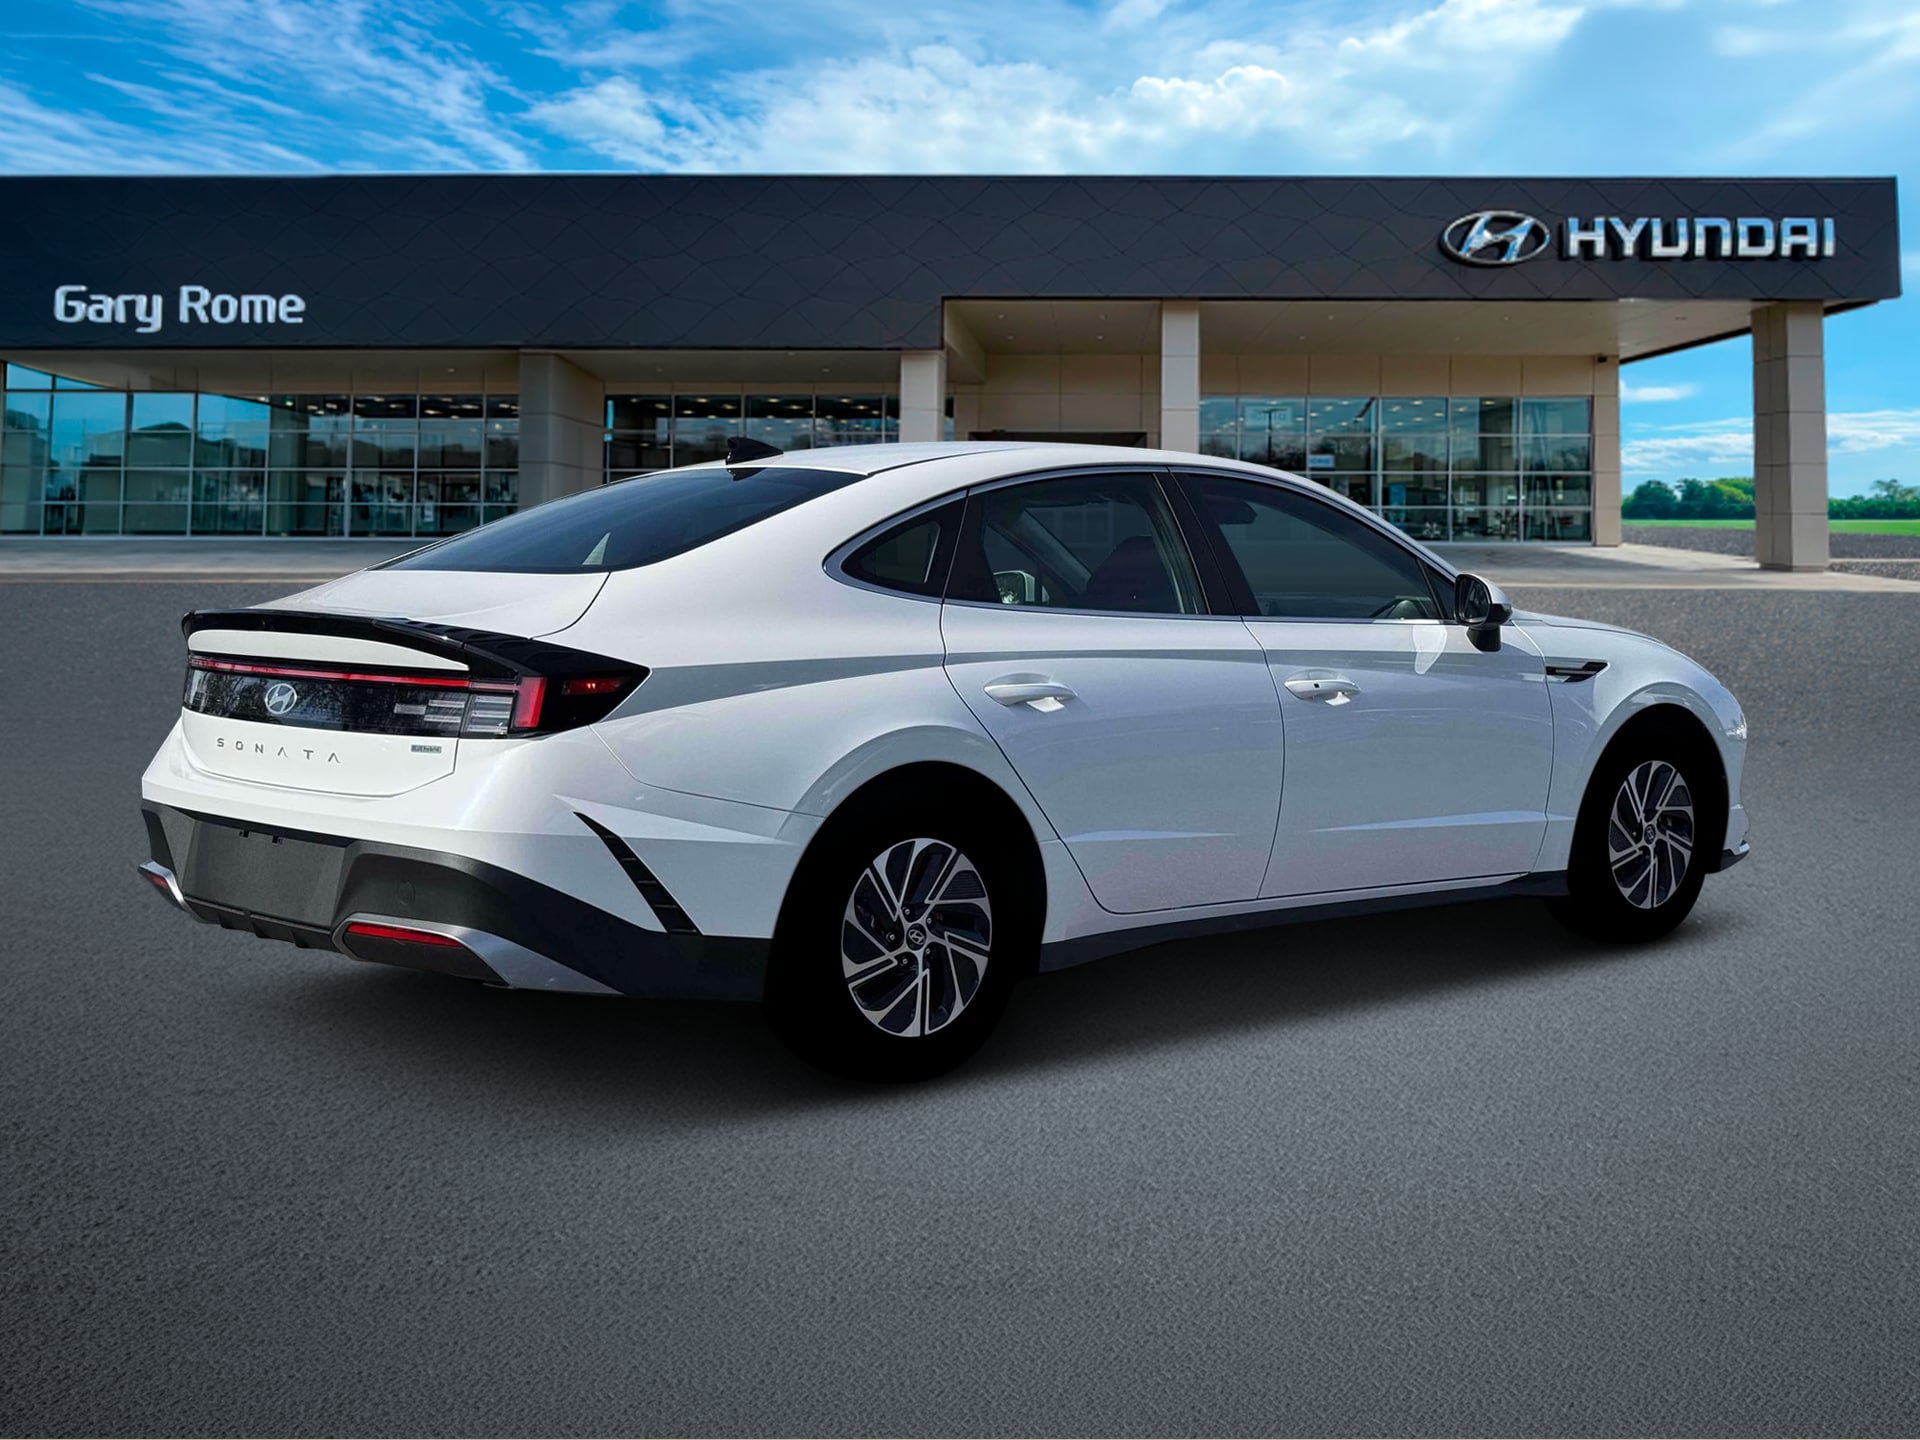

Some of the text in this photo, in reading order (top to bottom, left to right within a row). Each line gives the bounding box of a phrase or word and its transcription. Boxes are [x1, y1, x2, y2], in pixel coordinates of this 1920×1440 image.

[1567, 217, 1835, 256] HYUNDAI
[54, 285, 306, 333] Gary Rome
[216, 737, 341, 764] SONATA
